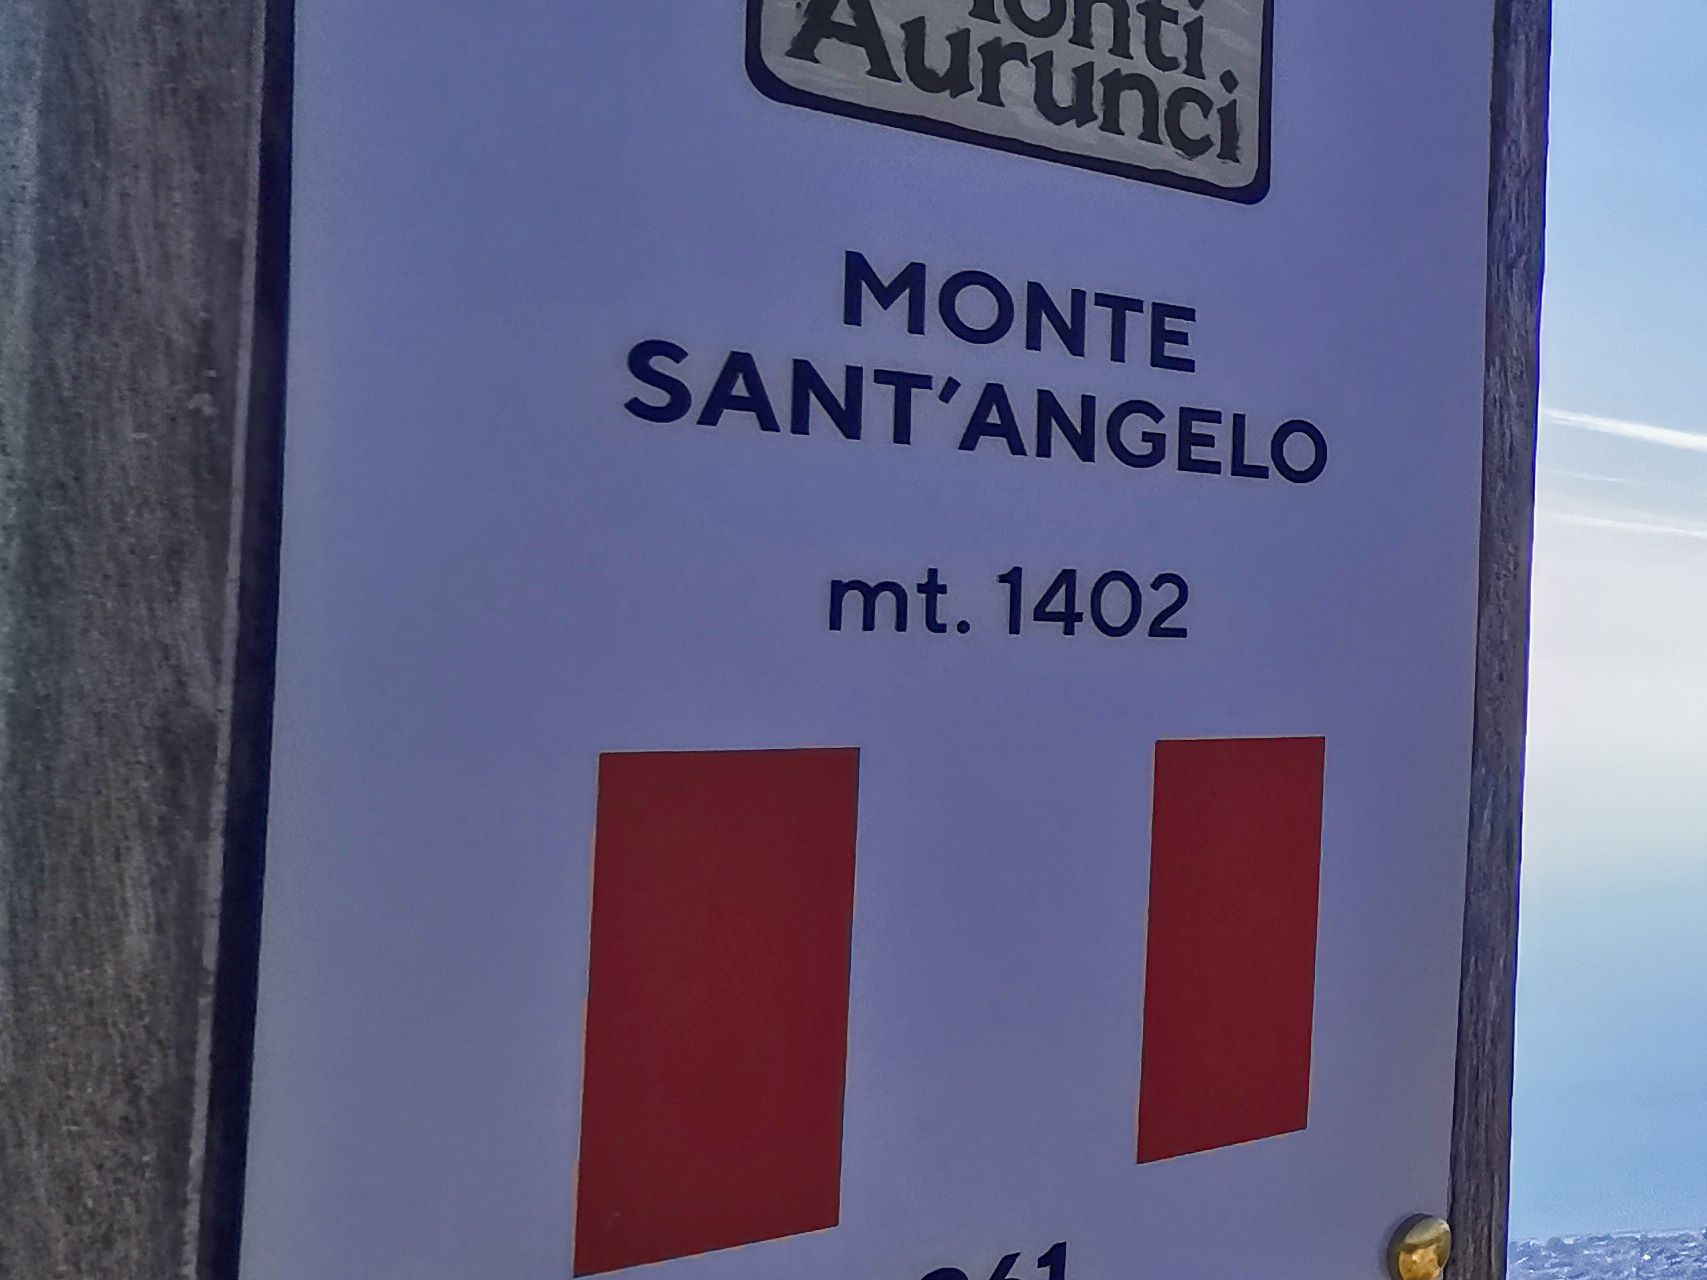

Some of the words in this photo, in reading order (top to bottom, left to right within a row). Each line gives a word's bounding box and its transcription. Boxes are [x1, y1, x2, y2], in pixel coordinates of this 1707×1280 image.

[843, 250, 1197, 373] MONTE
[623, 339, 1328, 484] SANT'ANGELO
[828, 567, 971, 635] mt.
[997, 566, 1190, 639] 1402
